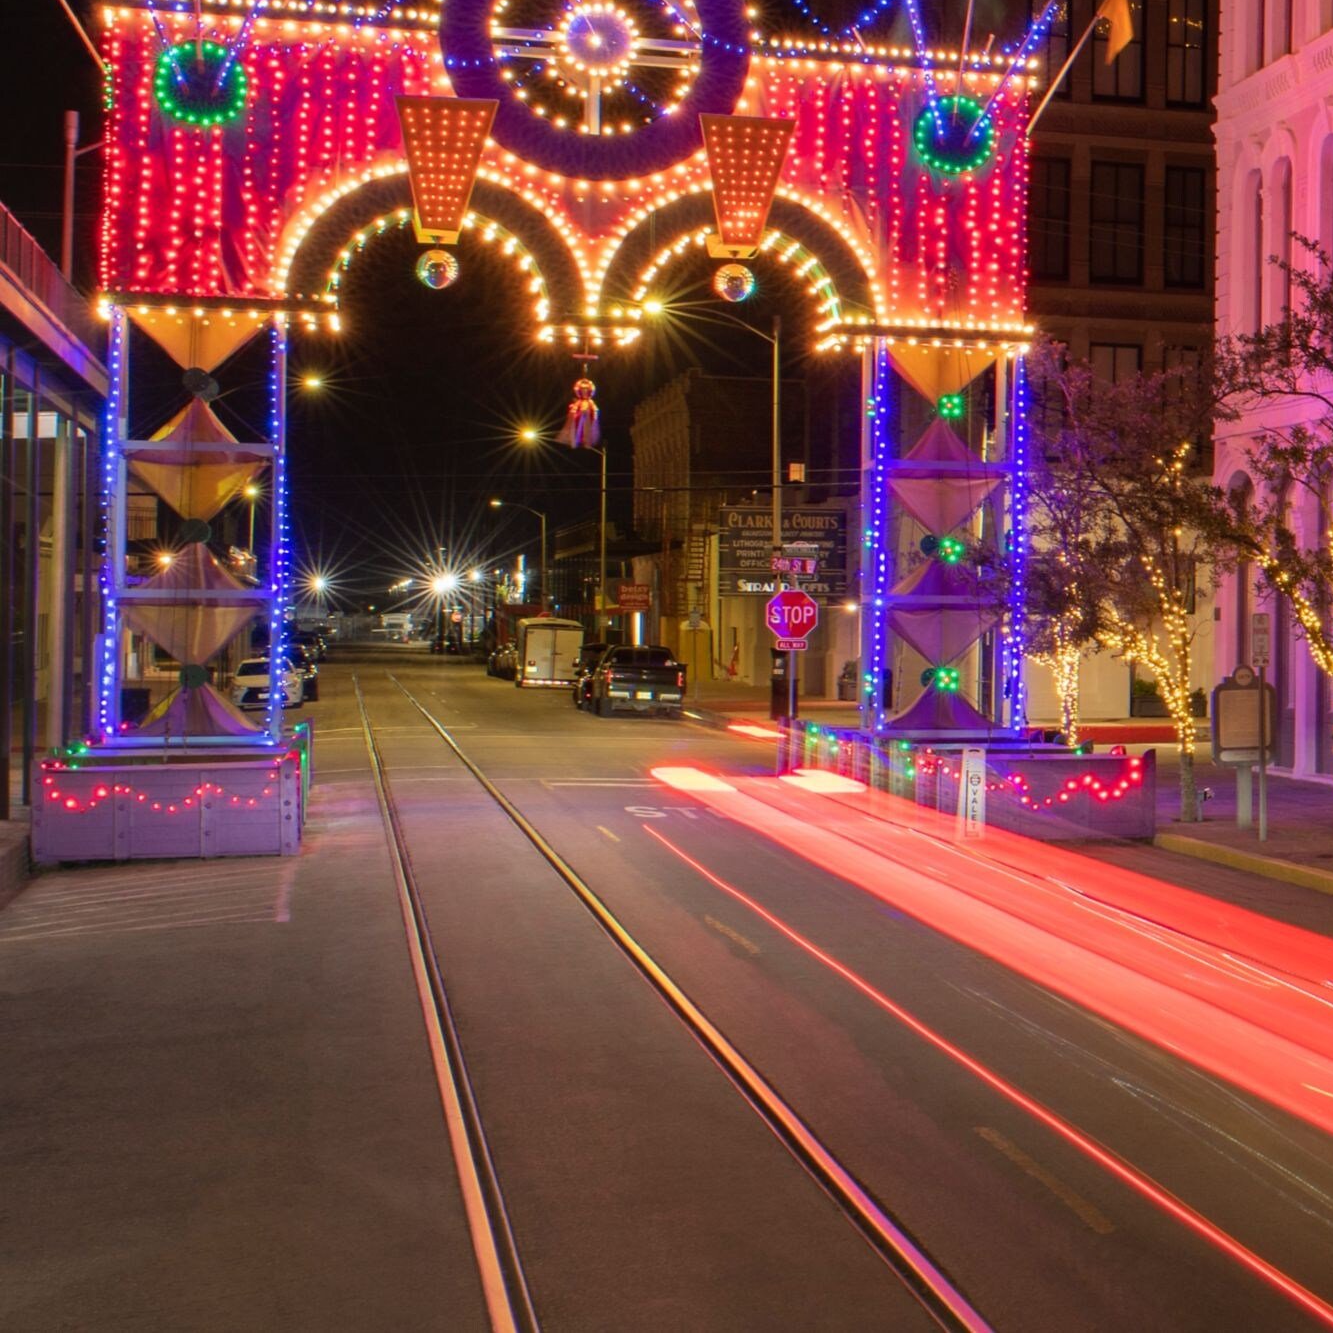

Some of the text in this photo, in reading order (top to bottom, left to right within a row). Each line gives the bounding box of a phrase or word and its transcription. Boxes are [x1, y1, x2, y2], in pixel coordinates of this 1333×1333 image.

[728, 512, 774, 528] CLARK
[792, 513, 838, 529] COURTS
[770, 606, 814, 624] STOP
